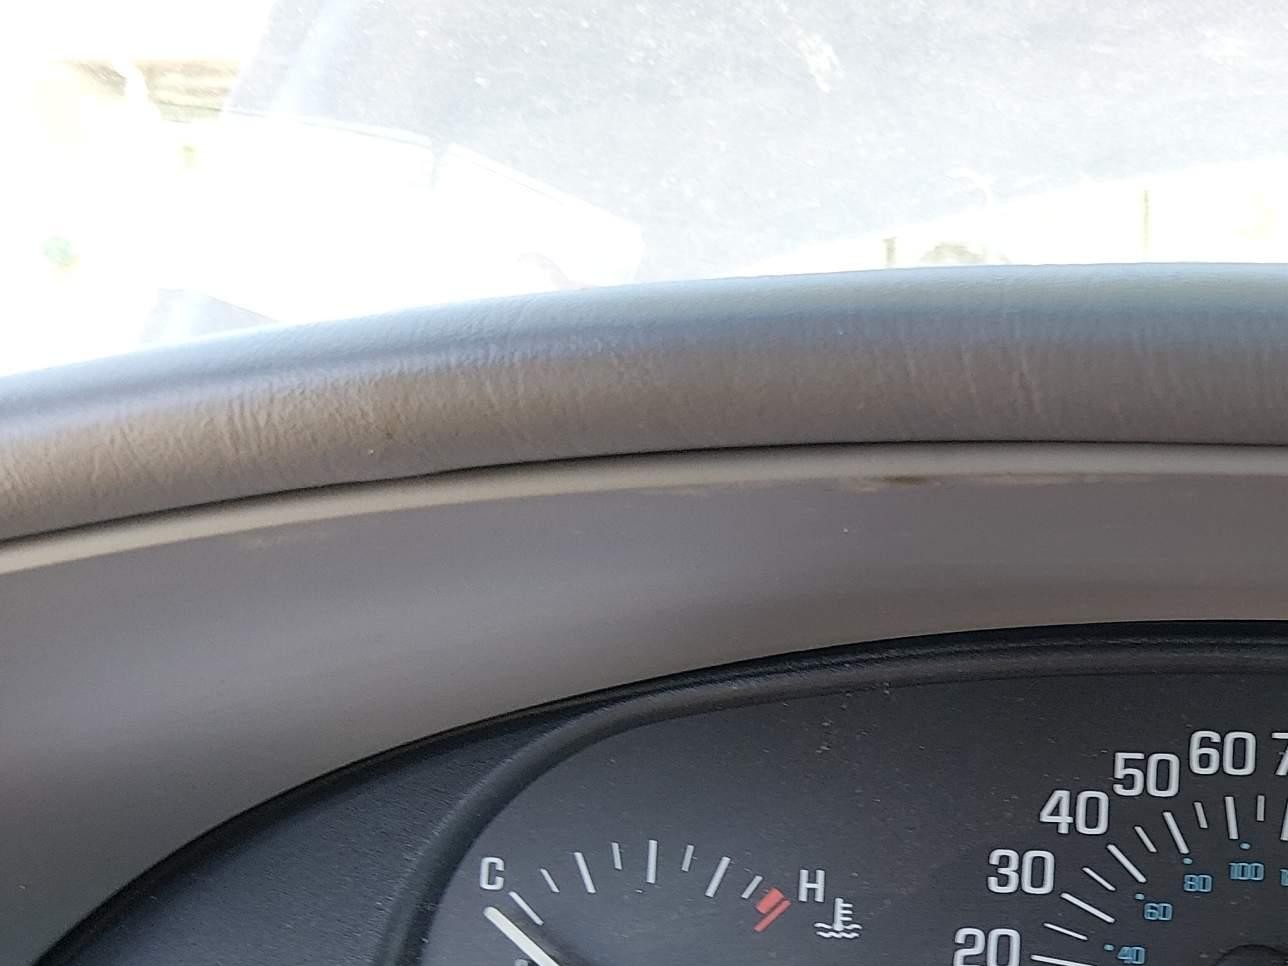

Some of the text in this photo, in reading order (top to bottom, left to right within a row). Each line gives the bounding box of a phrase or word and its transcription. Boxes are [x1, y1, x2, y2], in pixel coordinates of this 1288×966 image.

[1190, 731, 1256, 776] 60
[1113, 752, 1180, 798] 50
[1039, 790, 1109, 835] 40
[480, 857, 504, 891] C
[799, 869, 825, 902] H
[987, 849, 1055, 895] 30
[1183, 875, 1212, 892] 80
[1229, 862, 1264, 880] 100
[1143, 903, 1172, 920] 60
[1117, 946, 1145, 964] 40
